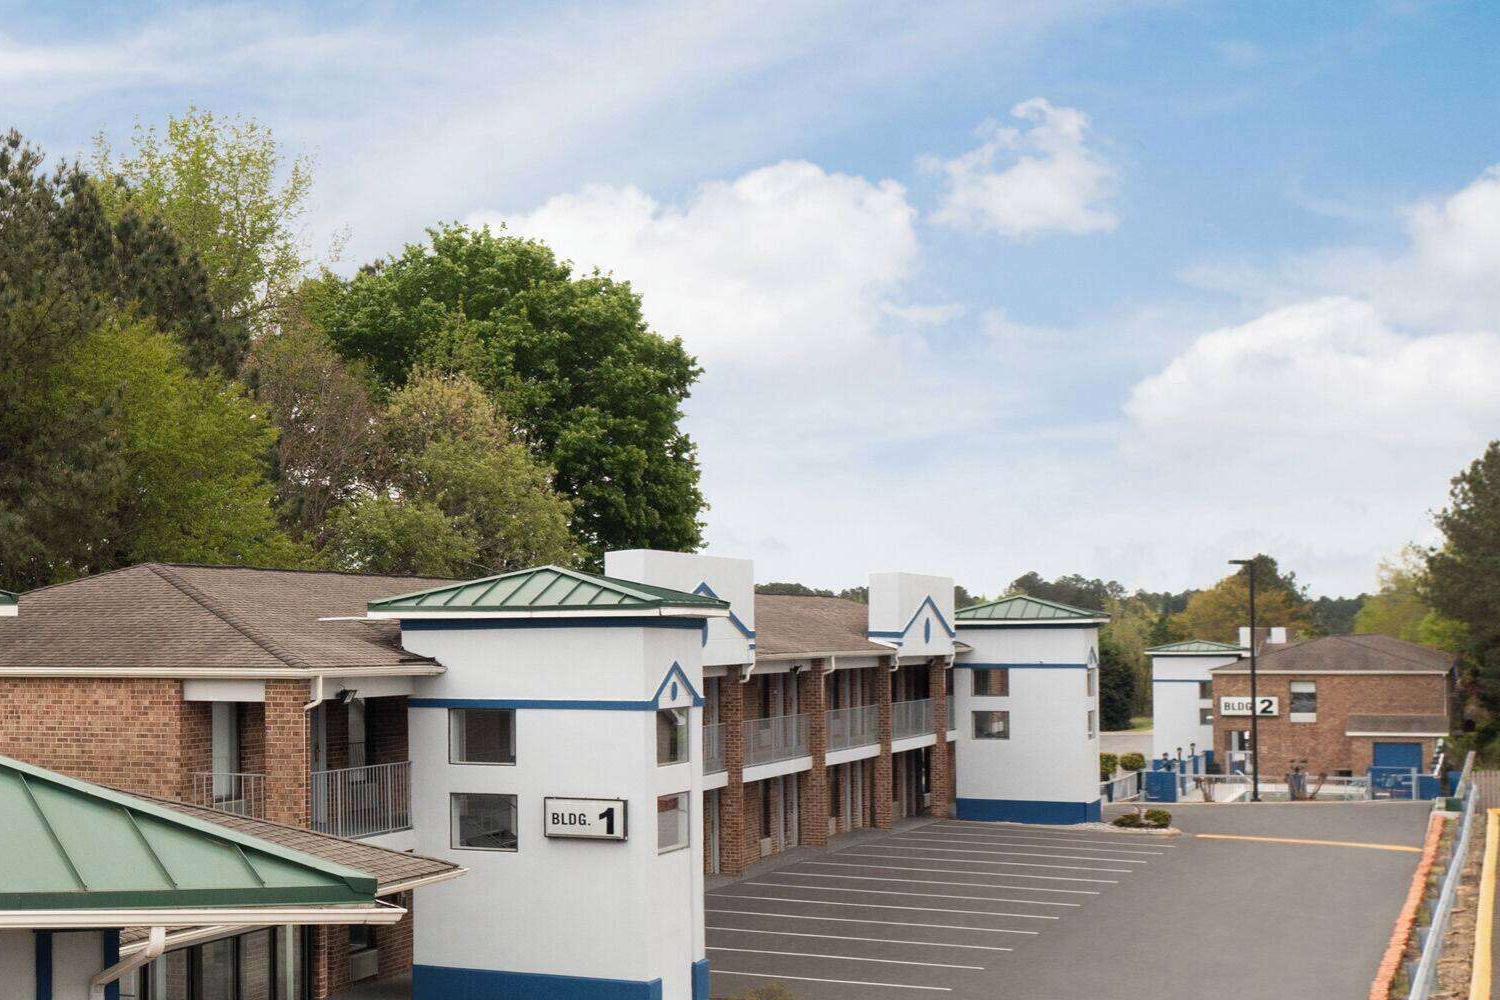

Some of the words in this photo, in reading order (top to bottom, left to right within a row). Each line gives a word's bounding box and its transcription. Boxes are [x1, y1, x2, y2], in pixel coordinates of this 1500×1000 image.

[1260, 699, 1274, 714] 2
[551, 812, 591, 826] BLDG.
[599, 807, 615, 835] 1
